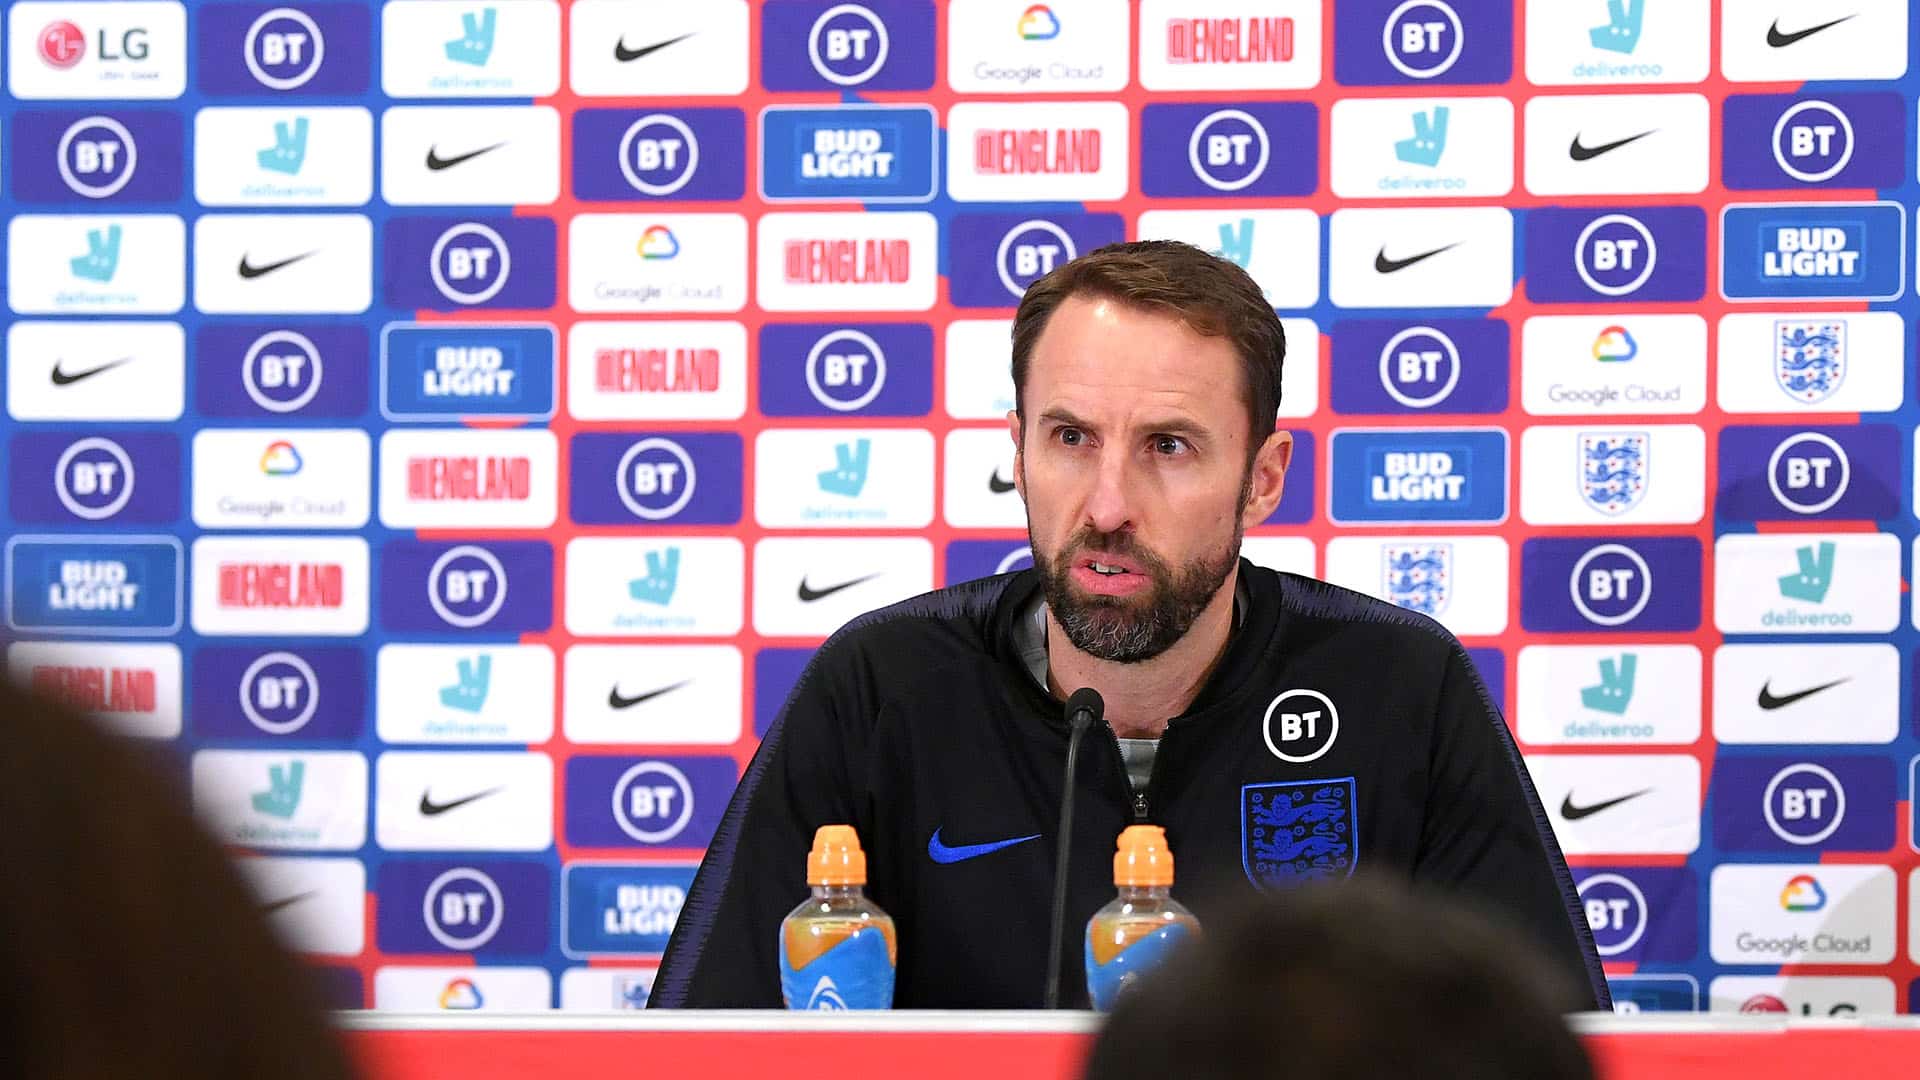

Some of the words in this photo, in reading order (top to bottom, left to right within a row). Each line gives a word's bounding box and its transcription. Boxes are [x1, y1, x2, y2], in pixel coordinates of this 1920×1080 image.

[98, 28, 149, 60] LG
[263, 34, 306, 64] BT
[828, 30, 870, 59] BT
[1403, 23, 1445, 52] BT
[974, 62, 1042, 84] Google
[1573, 61, 1662, 77] deliveroo
[638, 140, 681, 170] BT
[814, 129, 882, 152] BUD
[1208, 135, 1251, 165] BT
[1792, 126, 1835, 156] BT
[77, 142, 118, 172] BT
[801, 152, 893, 178] LIGHT
[1777, 228, 1847, 251] BUD
[450, 248, 492, 278] BT
[1016, 246, 1058, 275] BT
[1595, 240, 1638, 269] BT
[1764, 250, 1859, 276] LIGHT
[262, 356, 305, 386] BT
[435, 348, 504, 369] BUD
[825, 355, 867, 385] BT
[1399, 352, 1442, 382] BT
[424, 368, 514, 396] LIGHT
[1548, 384, 1618, 406] Google
[1625, 384, 1681, 402] Cloud
[1384, 453, 1453, 474] BUD
[1788, 458, 1831, 487] BT
[75, 463, 116, 494] BT
[635, 464, 678, 493] BT
[1373, 474, 1465, 501] LIGHT
[61, 561, 127, 582] BUD
[447, 571, 488, 601] BT
[1590, 570, 1633, 599] BT
[50, 581, 137, 609] LIGHT
[1761, 608, 1852, 626] deliveroo
[259, 678, 300, 708] BT
[1282, 711, 1320, 740] BT
[1563, 720, 1654, 737] deliveroo
[632, 787, 675, 817] BT
[1784, 789, 1826, 818] BT
[443, 894, 484, 924] BT
[617, 886, 685, 909] BUD
[604, 908, 676, 934] LIGH
[1585, 900, 1629, 930] BT
[1736, 932, 1808, 957] Google
[1813, 933, 1870, 953] Cloud
